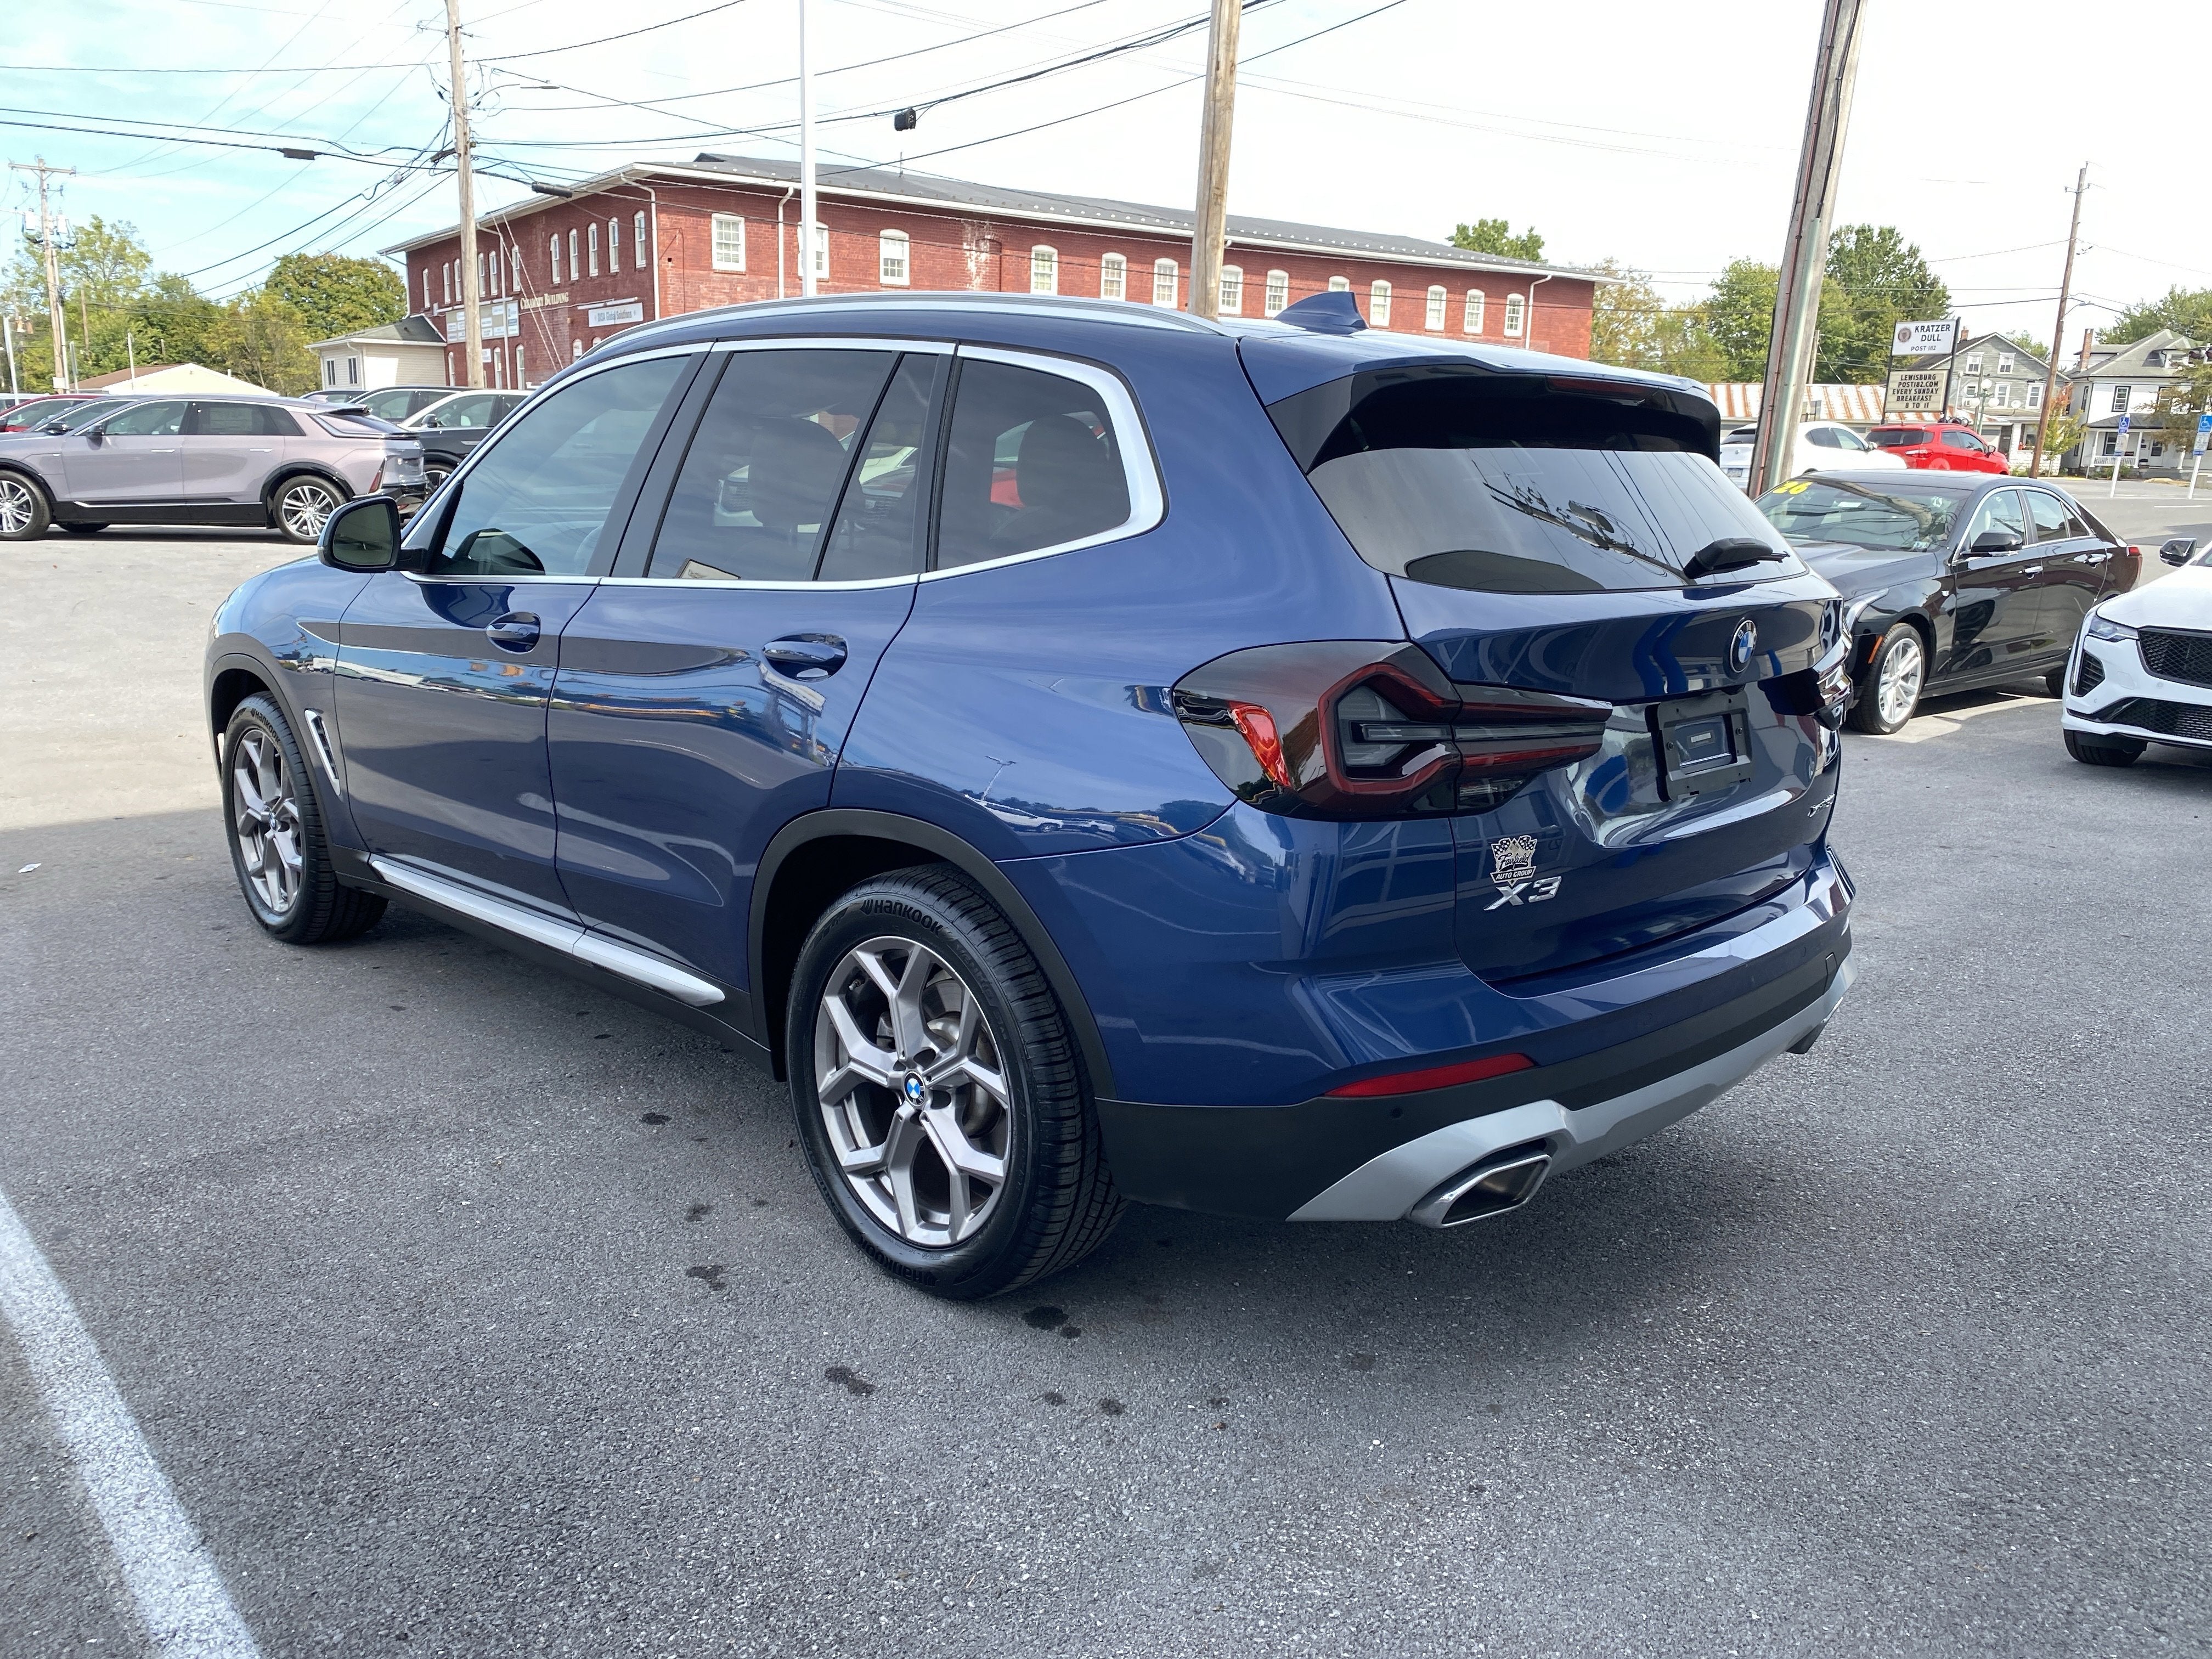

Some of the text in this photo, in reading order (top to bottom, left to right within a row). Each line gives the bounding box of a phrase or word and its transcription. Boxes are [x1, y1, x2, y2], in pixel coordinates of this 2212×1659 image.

[544, 292, 569, 306] BUILDING
[1915, 324, 1951, 333] KRATZER
[1498, 853, 1532, 871] Fairfield
[1513, 869, 1533, 878] GROUP
[1483, 876, 1562, 911] X3
